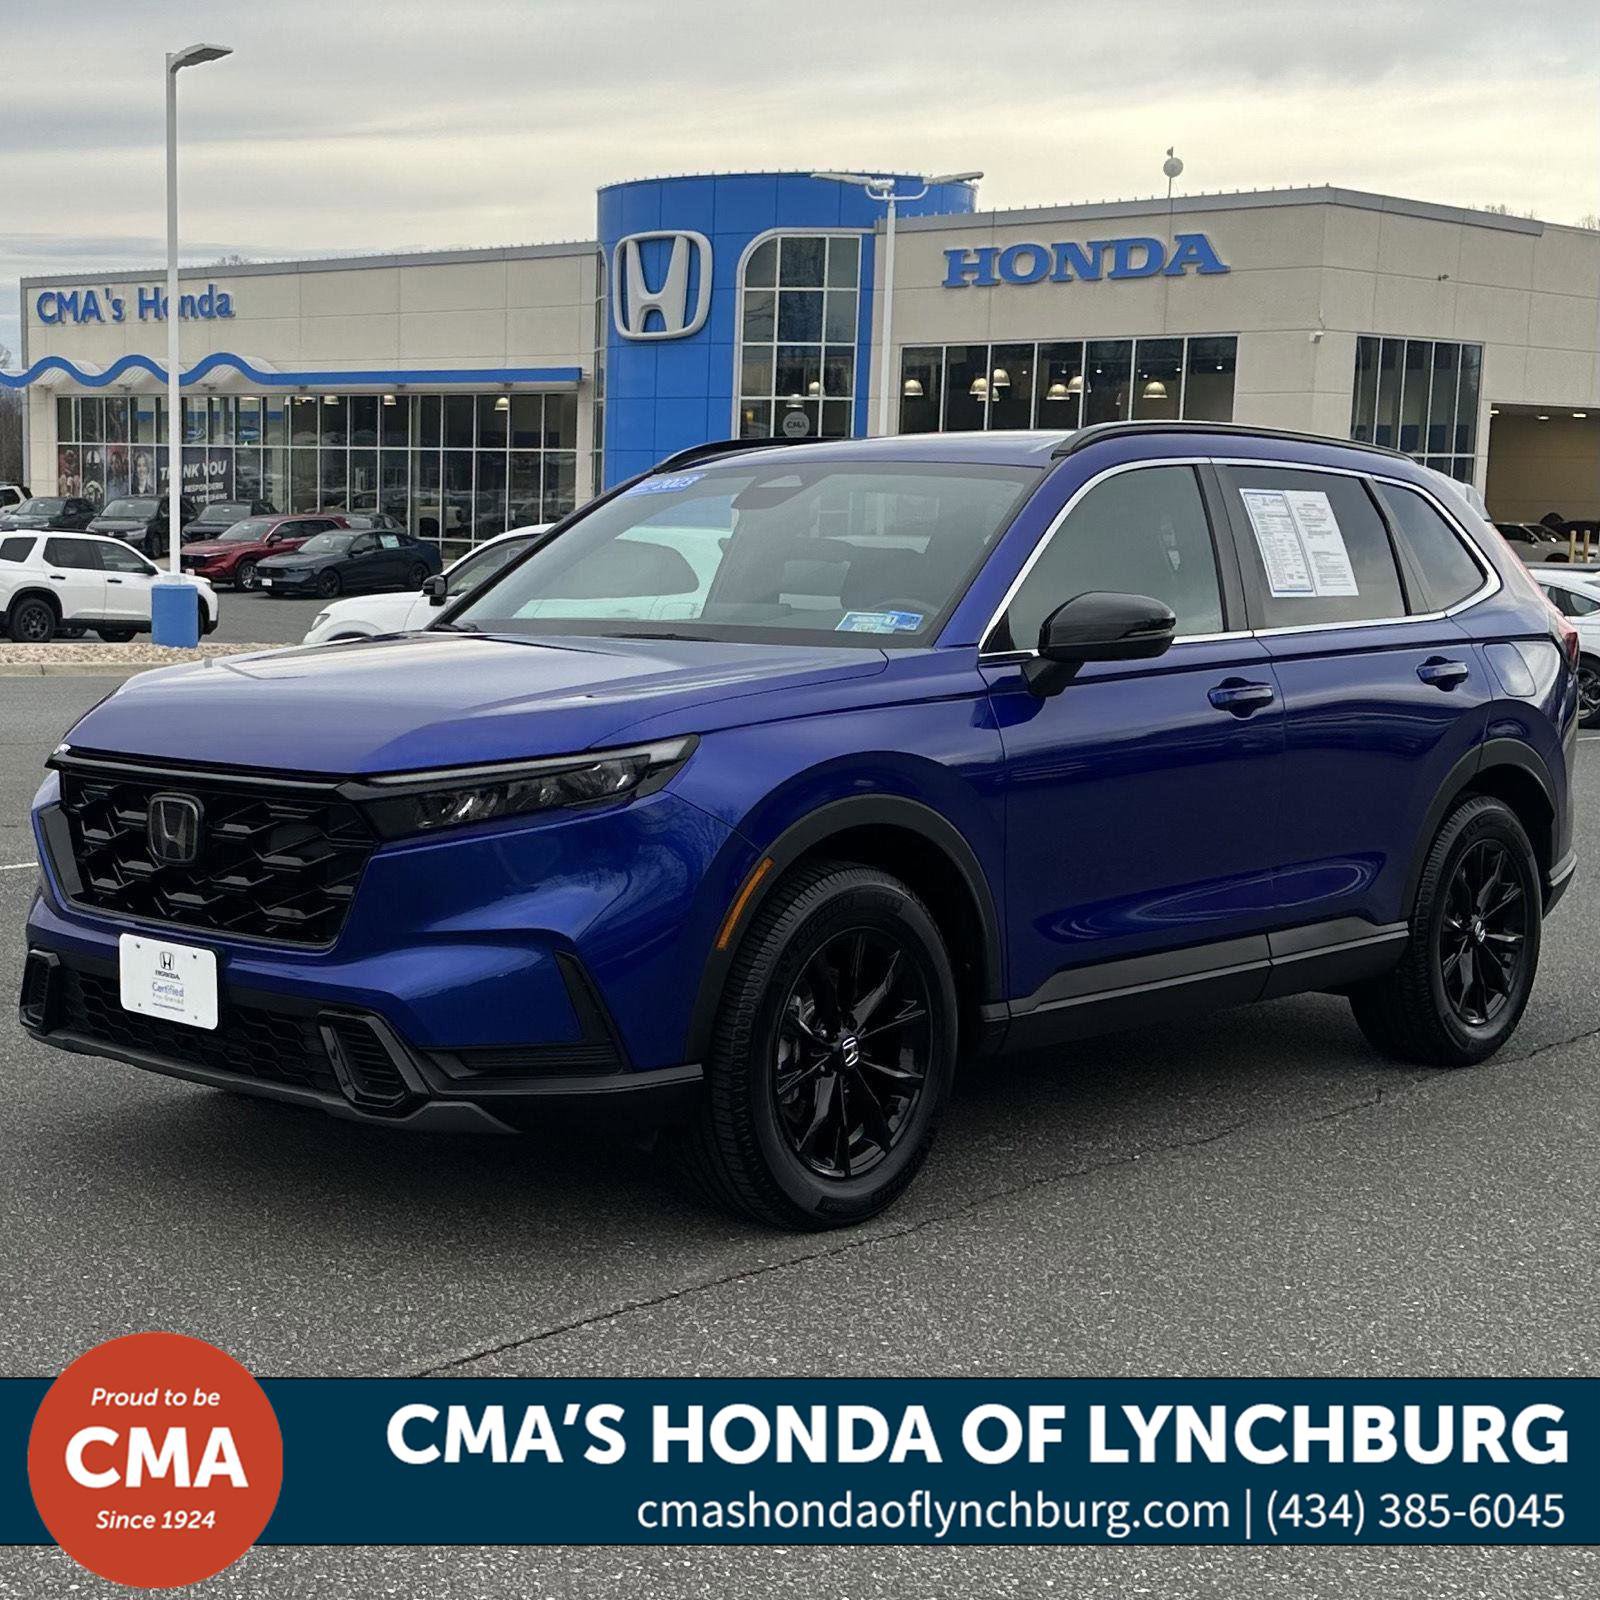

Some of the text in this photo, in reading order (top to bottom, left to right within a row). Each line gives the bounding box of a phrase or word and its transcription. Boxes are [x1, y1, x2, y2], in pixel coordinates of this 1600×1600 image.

[941, 233, 1231, 288] HONDA
[36, 288, 125, 324] CMA's
[160, 460, 227, 481] TNK YOU
[155, 969, 180, 980] HONDA
